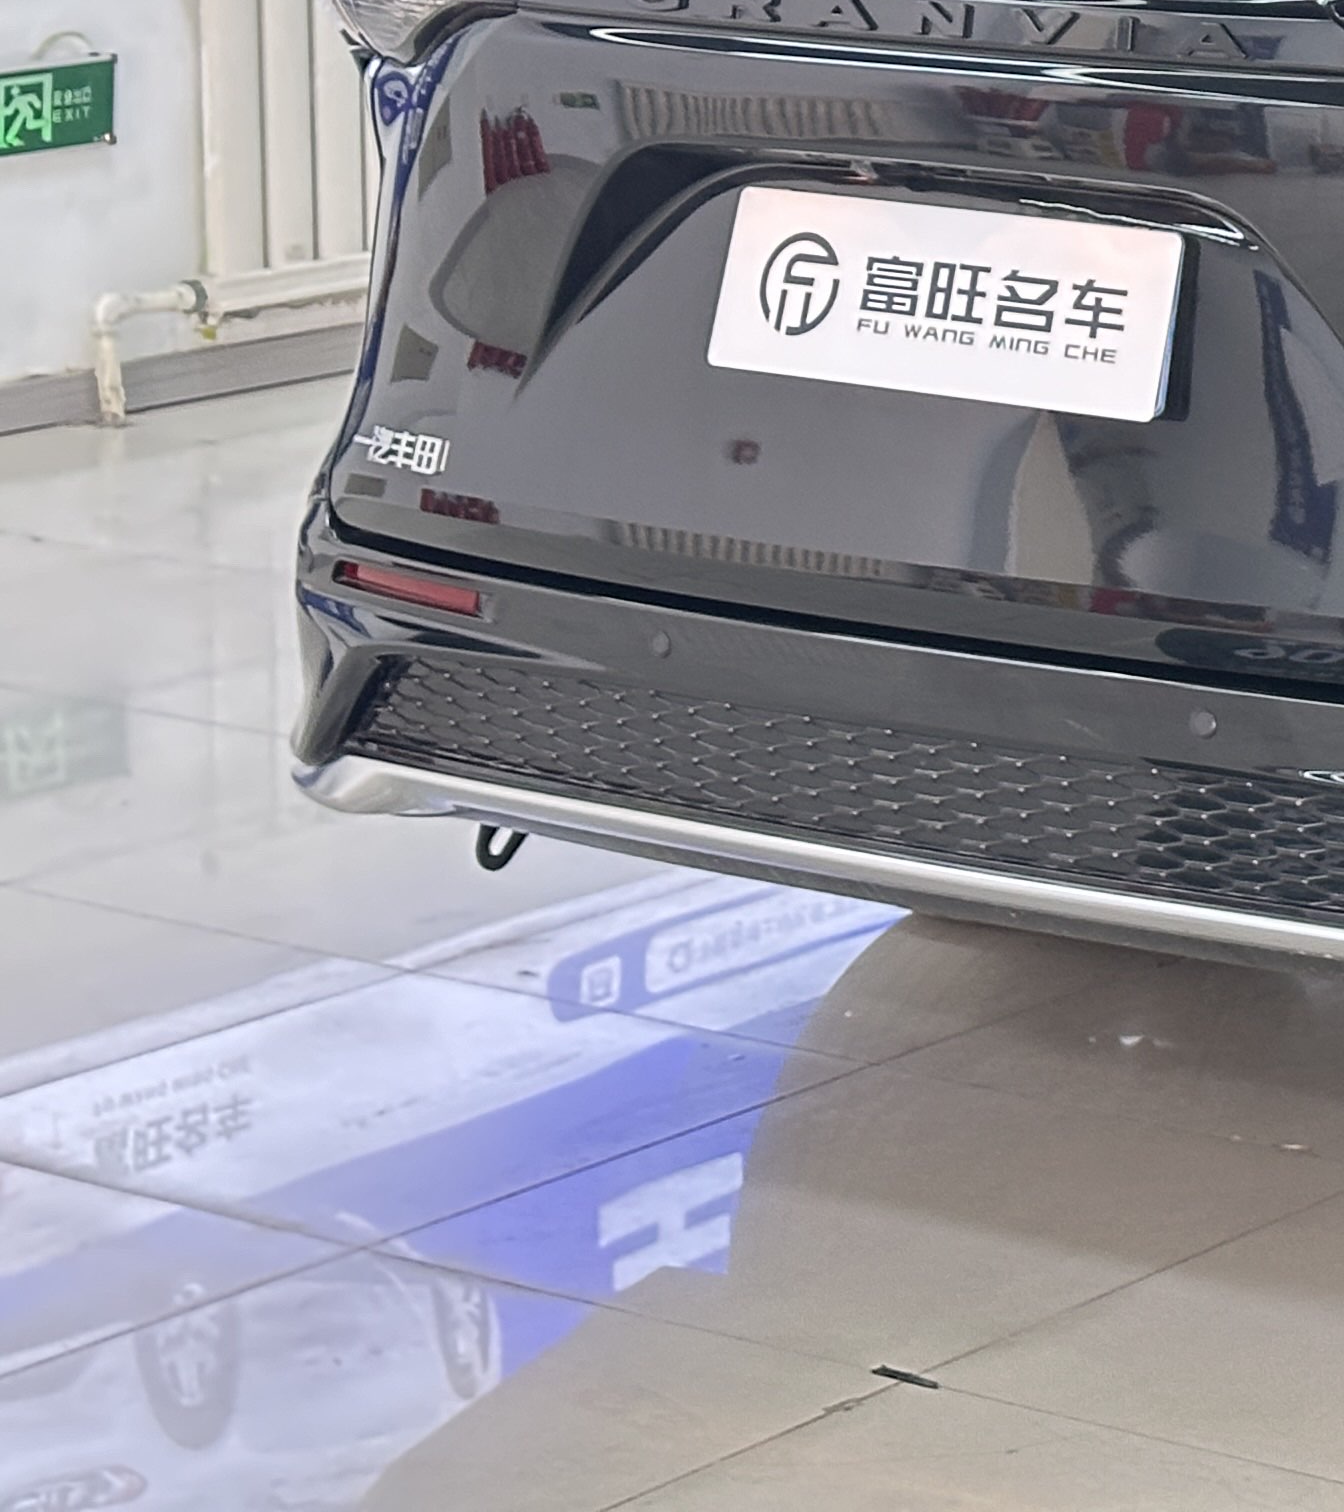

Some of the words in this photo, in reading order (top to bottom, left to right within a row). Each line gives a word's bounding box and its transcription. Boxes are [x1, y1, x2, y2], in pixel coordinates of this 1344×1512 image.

[53, 105, 90, 124] EXIT
[859, 255, 1128, 340] 富旺名车
[856, 318, 891, 335] FU
[903, 324, 975, 347] WANG
[988, 335, 1051, 357] MING
[1063, 344, 1118, 365] CHE
[353, 424, 450, 475] 一汽丰田
